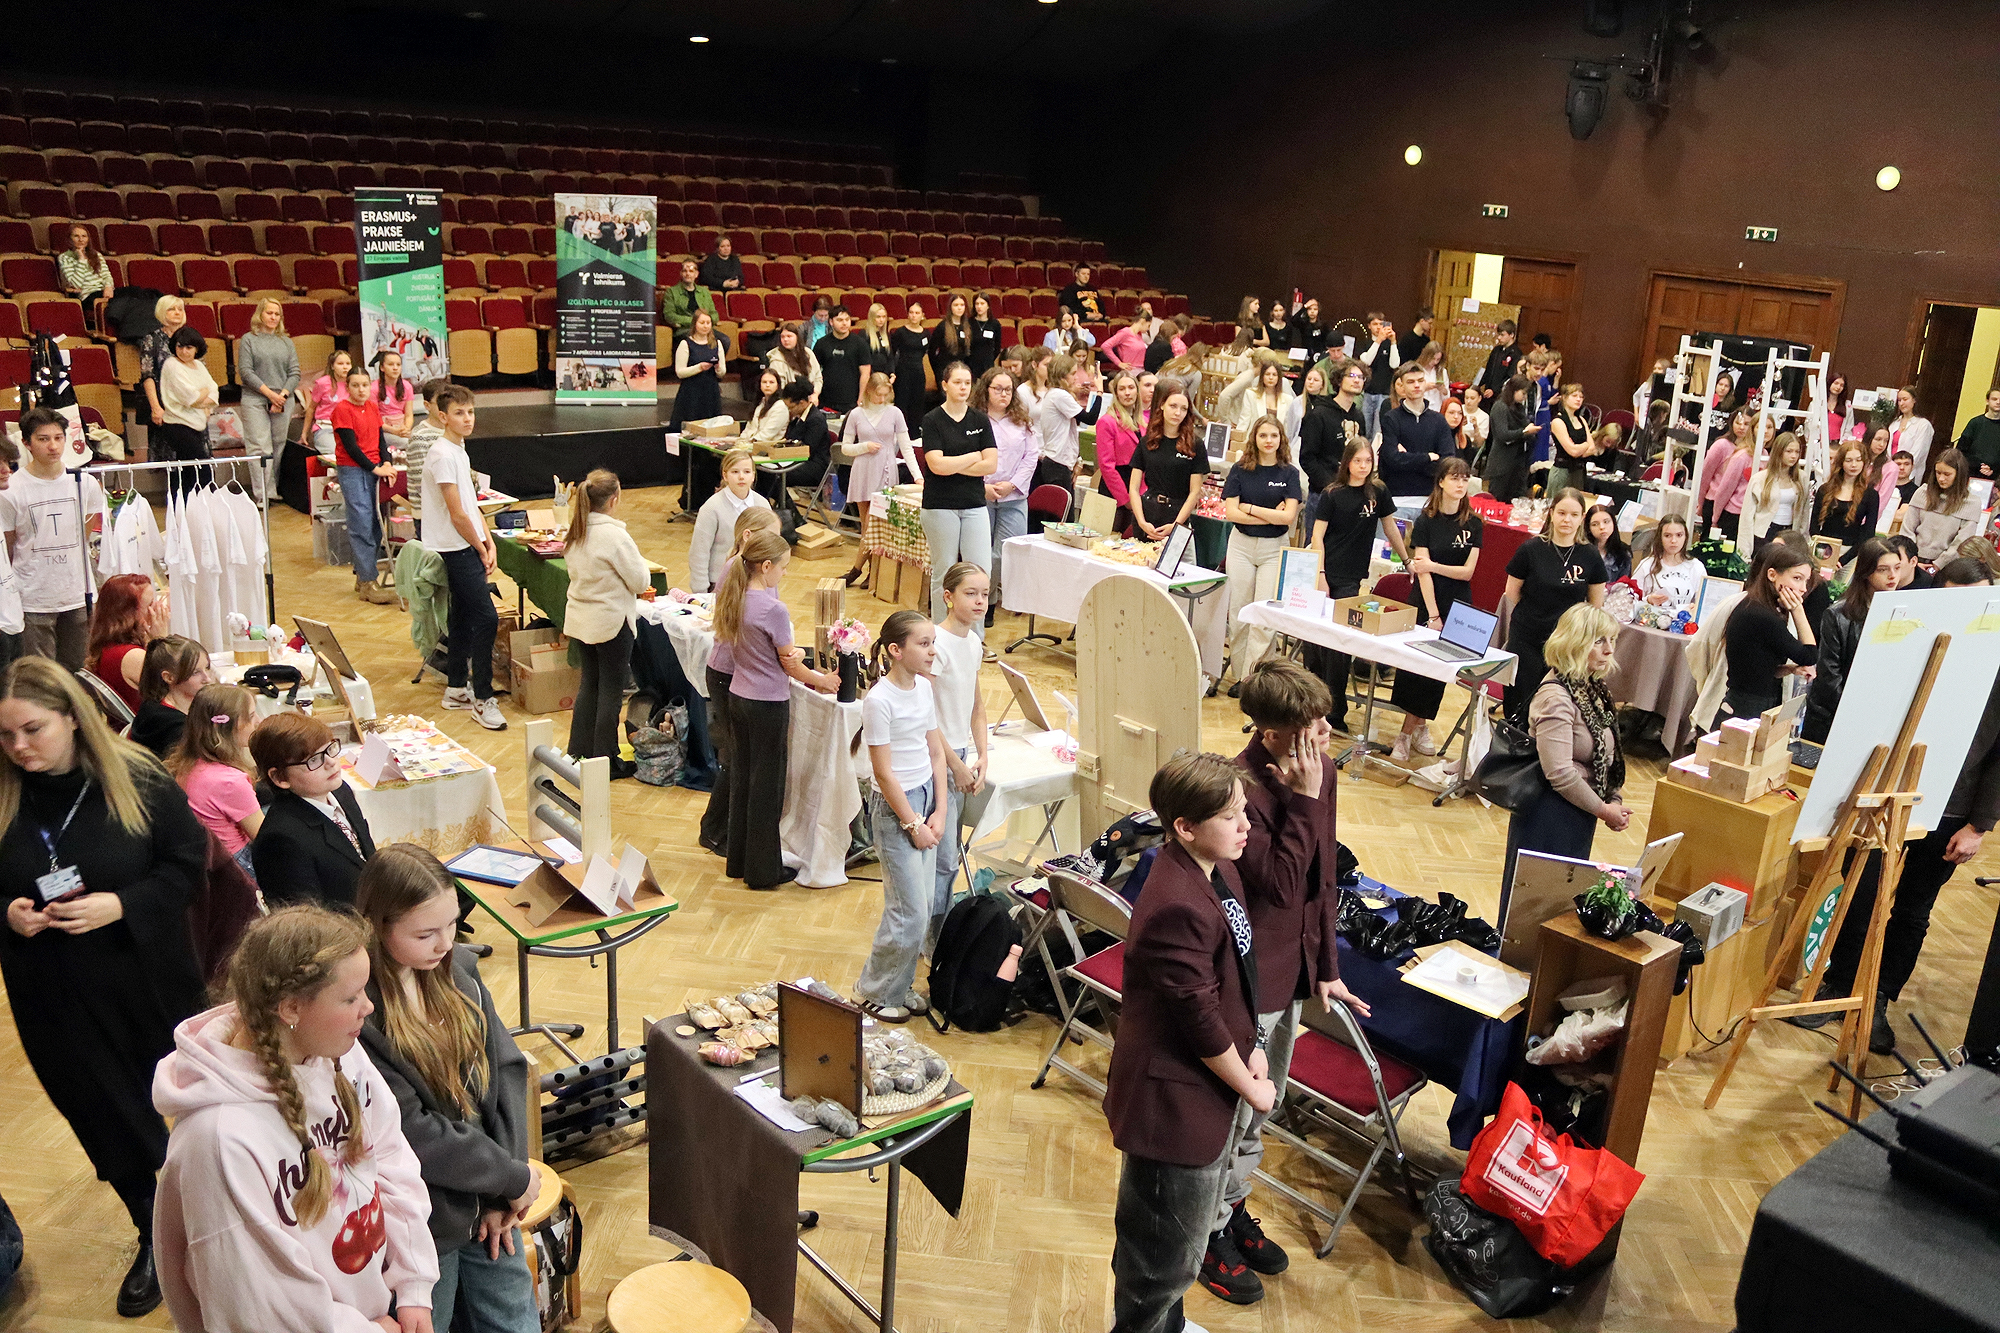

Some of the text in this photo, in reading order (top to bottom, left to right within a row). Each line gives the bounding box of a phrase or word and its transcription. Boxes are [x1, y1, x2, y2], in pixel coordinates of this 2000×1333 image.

[361, 211, 418, 223] ERASMUS+
[362, 226, 403, 238] PRAKSE
[363, 238, 425, 252] JAUNIEŠIEM
[593, 272, 624, 280] Valmieras
[593, 279, 626, 287] tehnikums
[567, 298, 599, 307] IZGLĪTĪBA
[600, 298, 613, 307] PĒC
[46, 513, 63, 536] T
[1454, 530, 1472, 547] AP
[1563, 564, 1584, 584] AP
[1498, 1163, 1545, 1198] Kaufland
